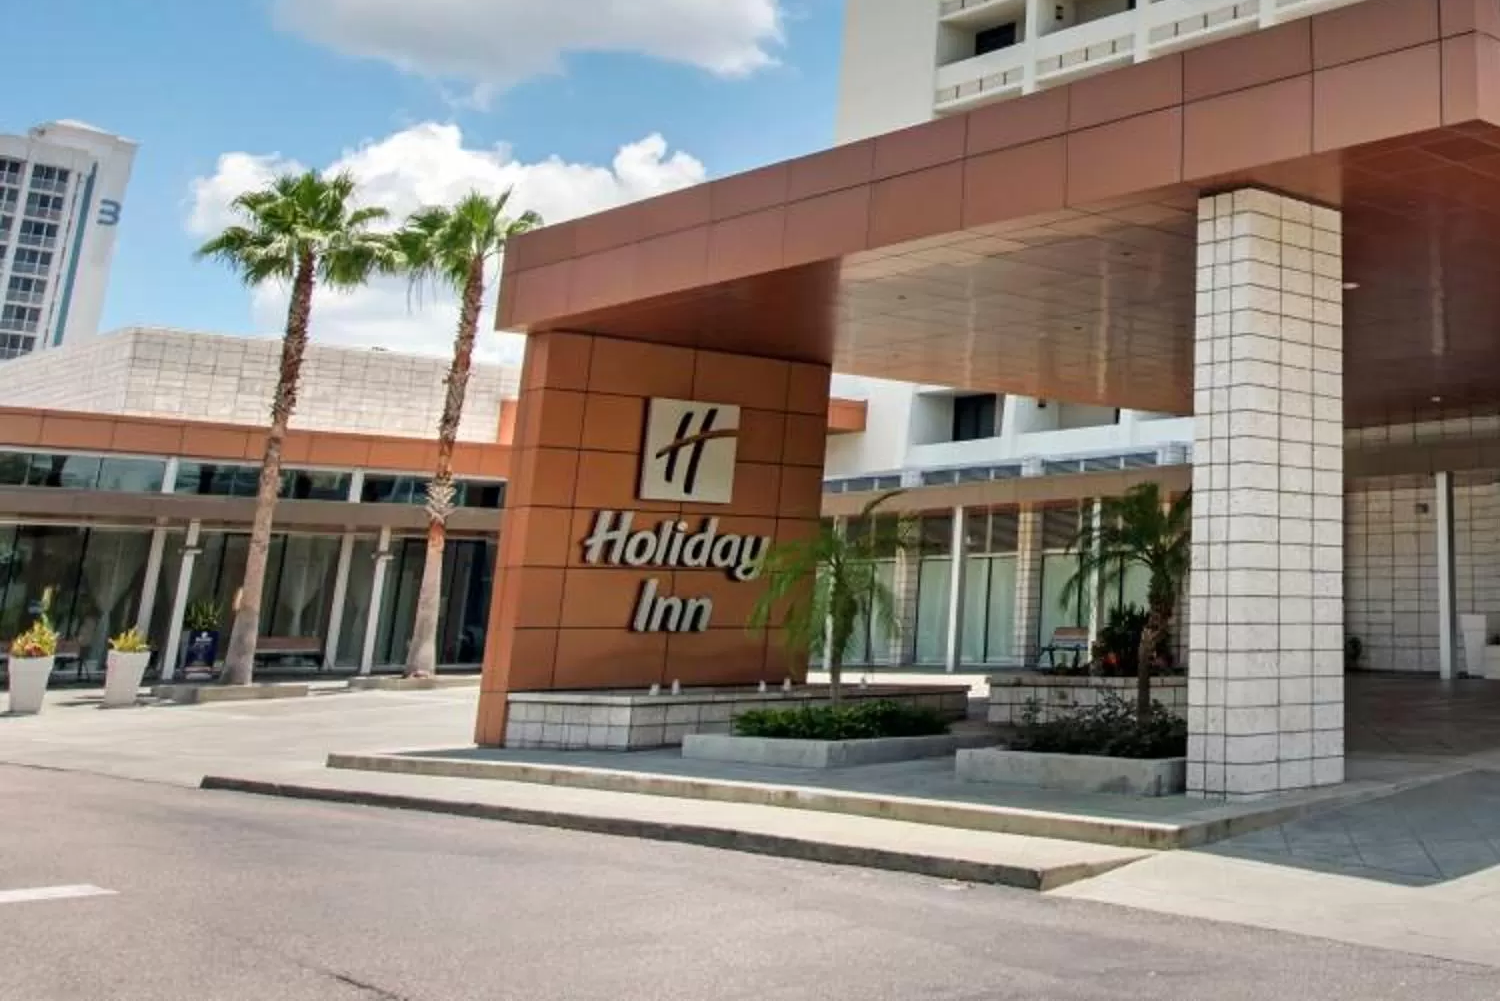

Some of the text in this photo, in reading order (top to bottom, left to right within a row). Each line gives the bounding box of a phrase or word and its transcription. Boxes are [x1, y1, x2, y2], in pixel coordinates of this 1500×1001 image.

[655, 408, 737, 494] H
[585, 510, 770, 581] Holiday
[632, 578, 713, 632] Inn
